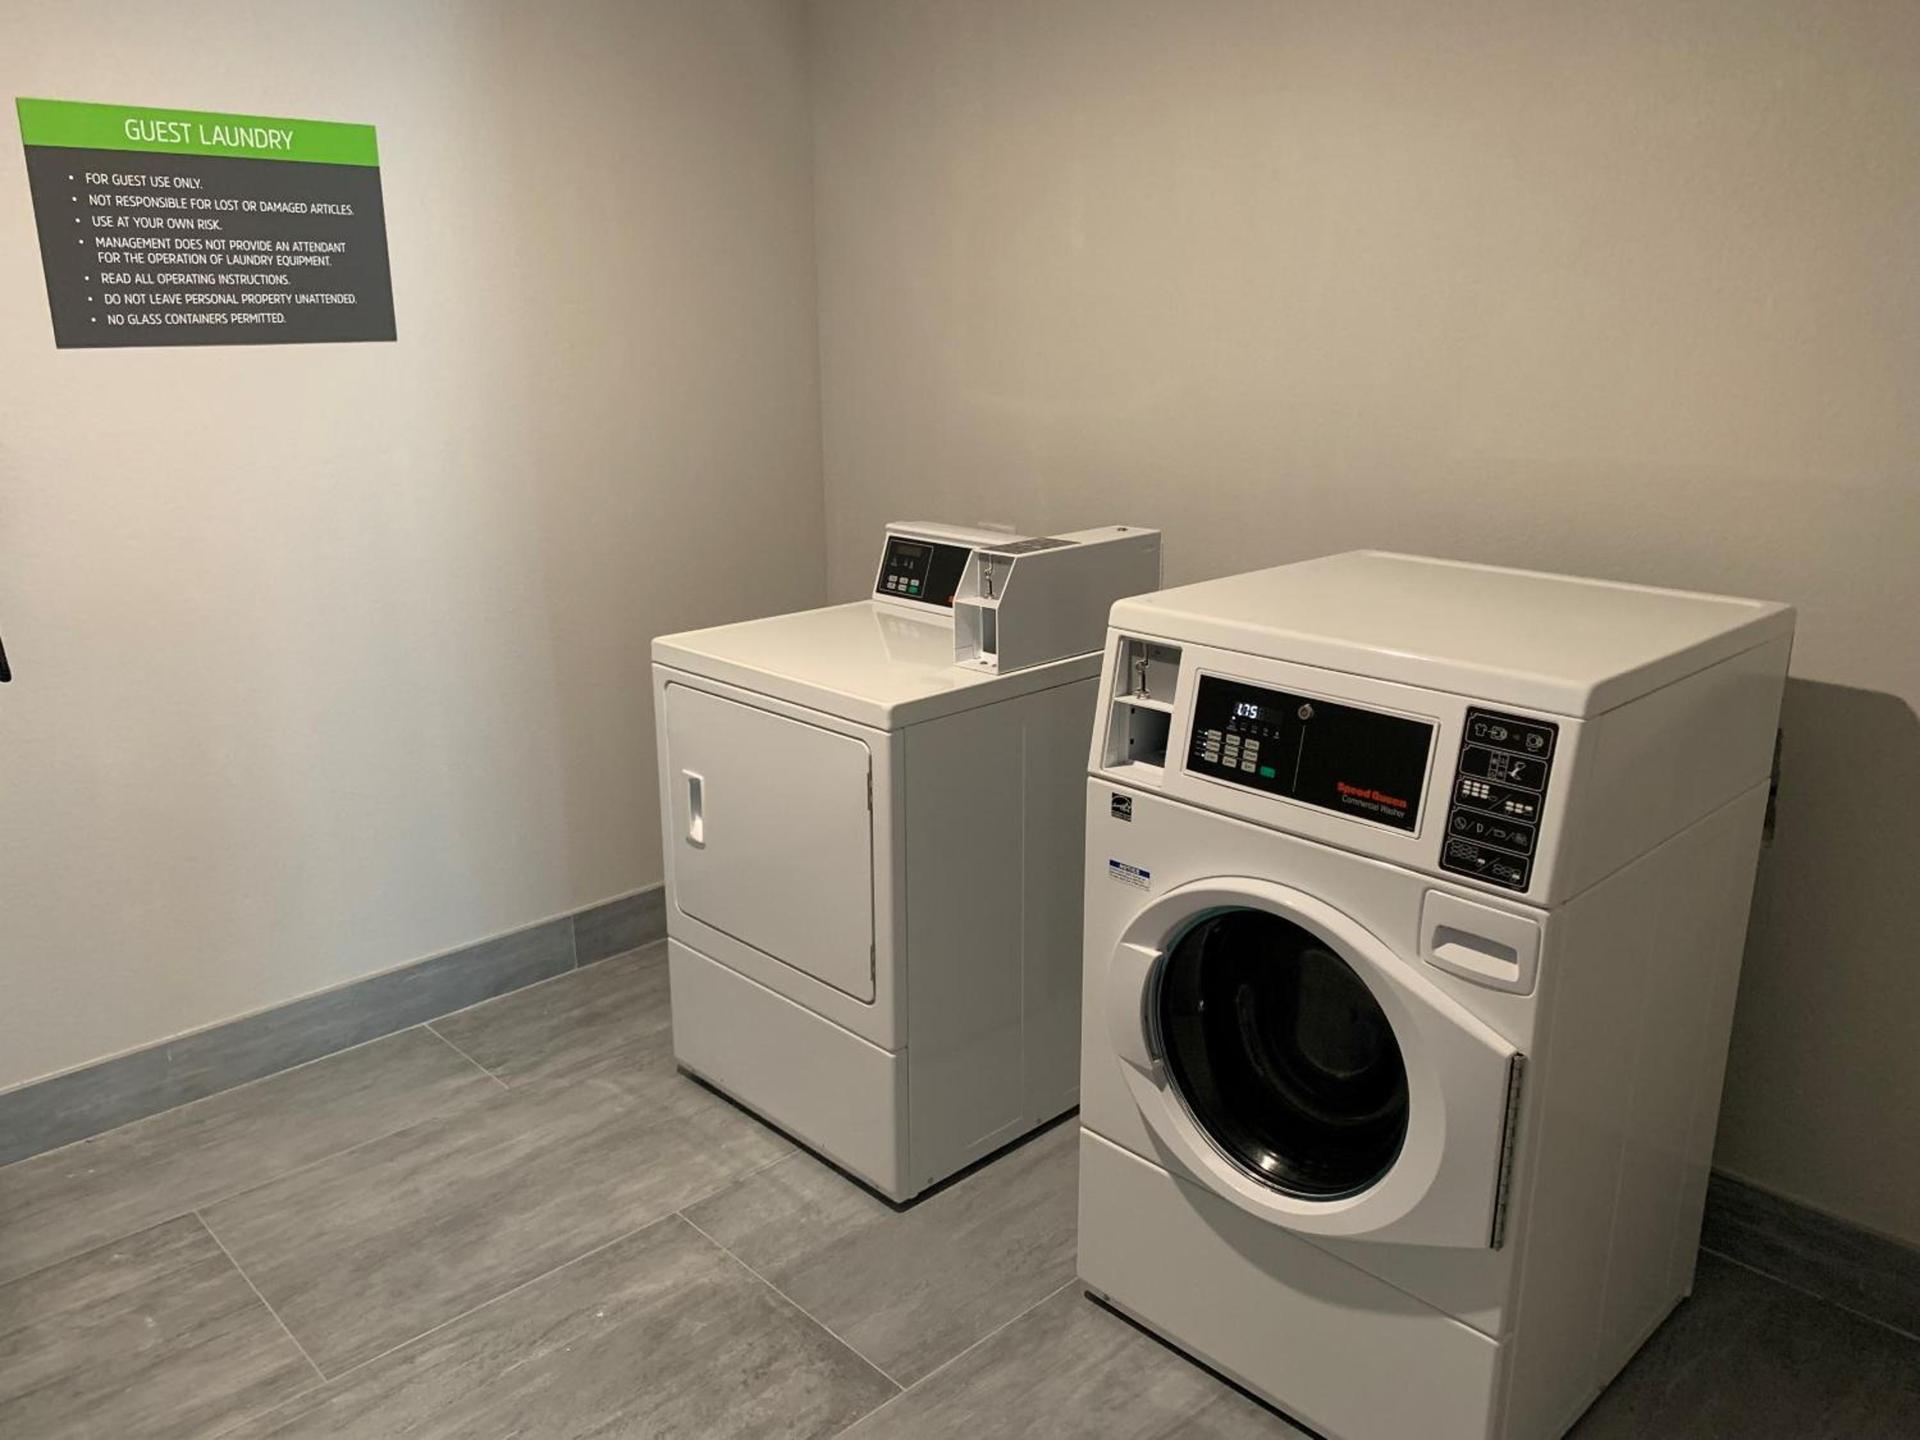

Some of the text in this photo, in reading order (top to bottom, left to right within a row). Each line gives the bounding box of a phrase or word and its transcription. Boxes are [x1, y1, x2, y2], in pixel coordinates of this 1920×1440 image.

[125, 119, 292, 149] GUEST LAUNDRY
[86, 173, 202, 189] FOR GUEST USE ONLY.
[89, 195, 353, 215] NOT RESPONSIBLE FOR LOST OR DAMAGED ARTICLES.
[92, 216, 222, 230] USE AT YOUR OWN RISK.
[95, 236, 345, 252] MANAGEMENT DOES NOT PROVIDE AN ATTENDANT
[98, 252, 331, 266] FOR THE OPERATION OF LAUNDRY EQUIPMENT.
[101, 273, 290, 285] READ ALL OPERATING INSTRUCTIONS.
[105, 294, 357, 304] DO NOT LEAVE PERSONAL PROPERTY UNATTENDED.
[108, 313, 285, 325] NO GLASS CONTAINERS PERMITTED.
[1337, 781, 1407, 809] Speed Queen
